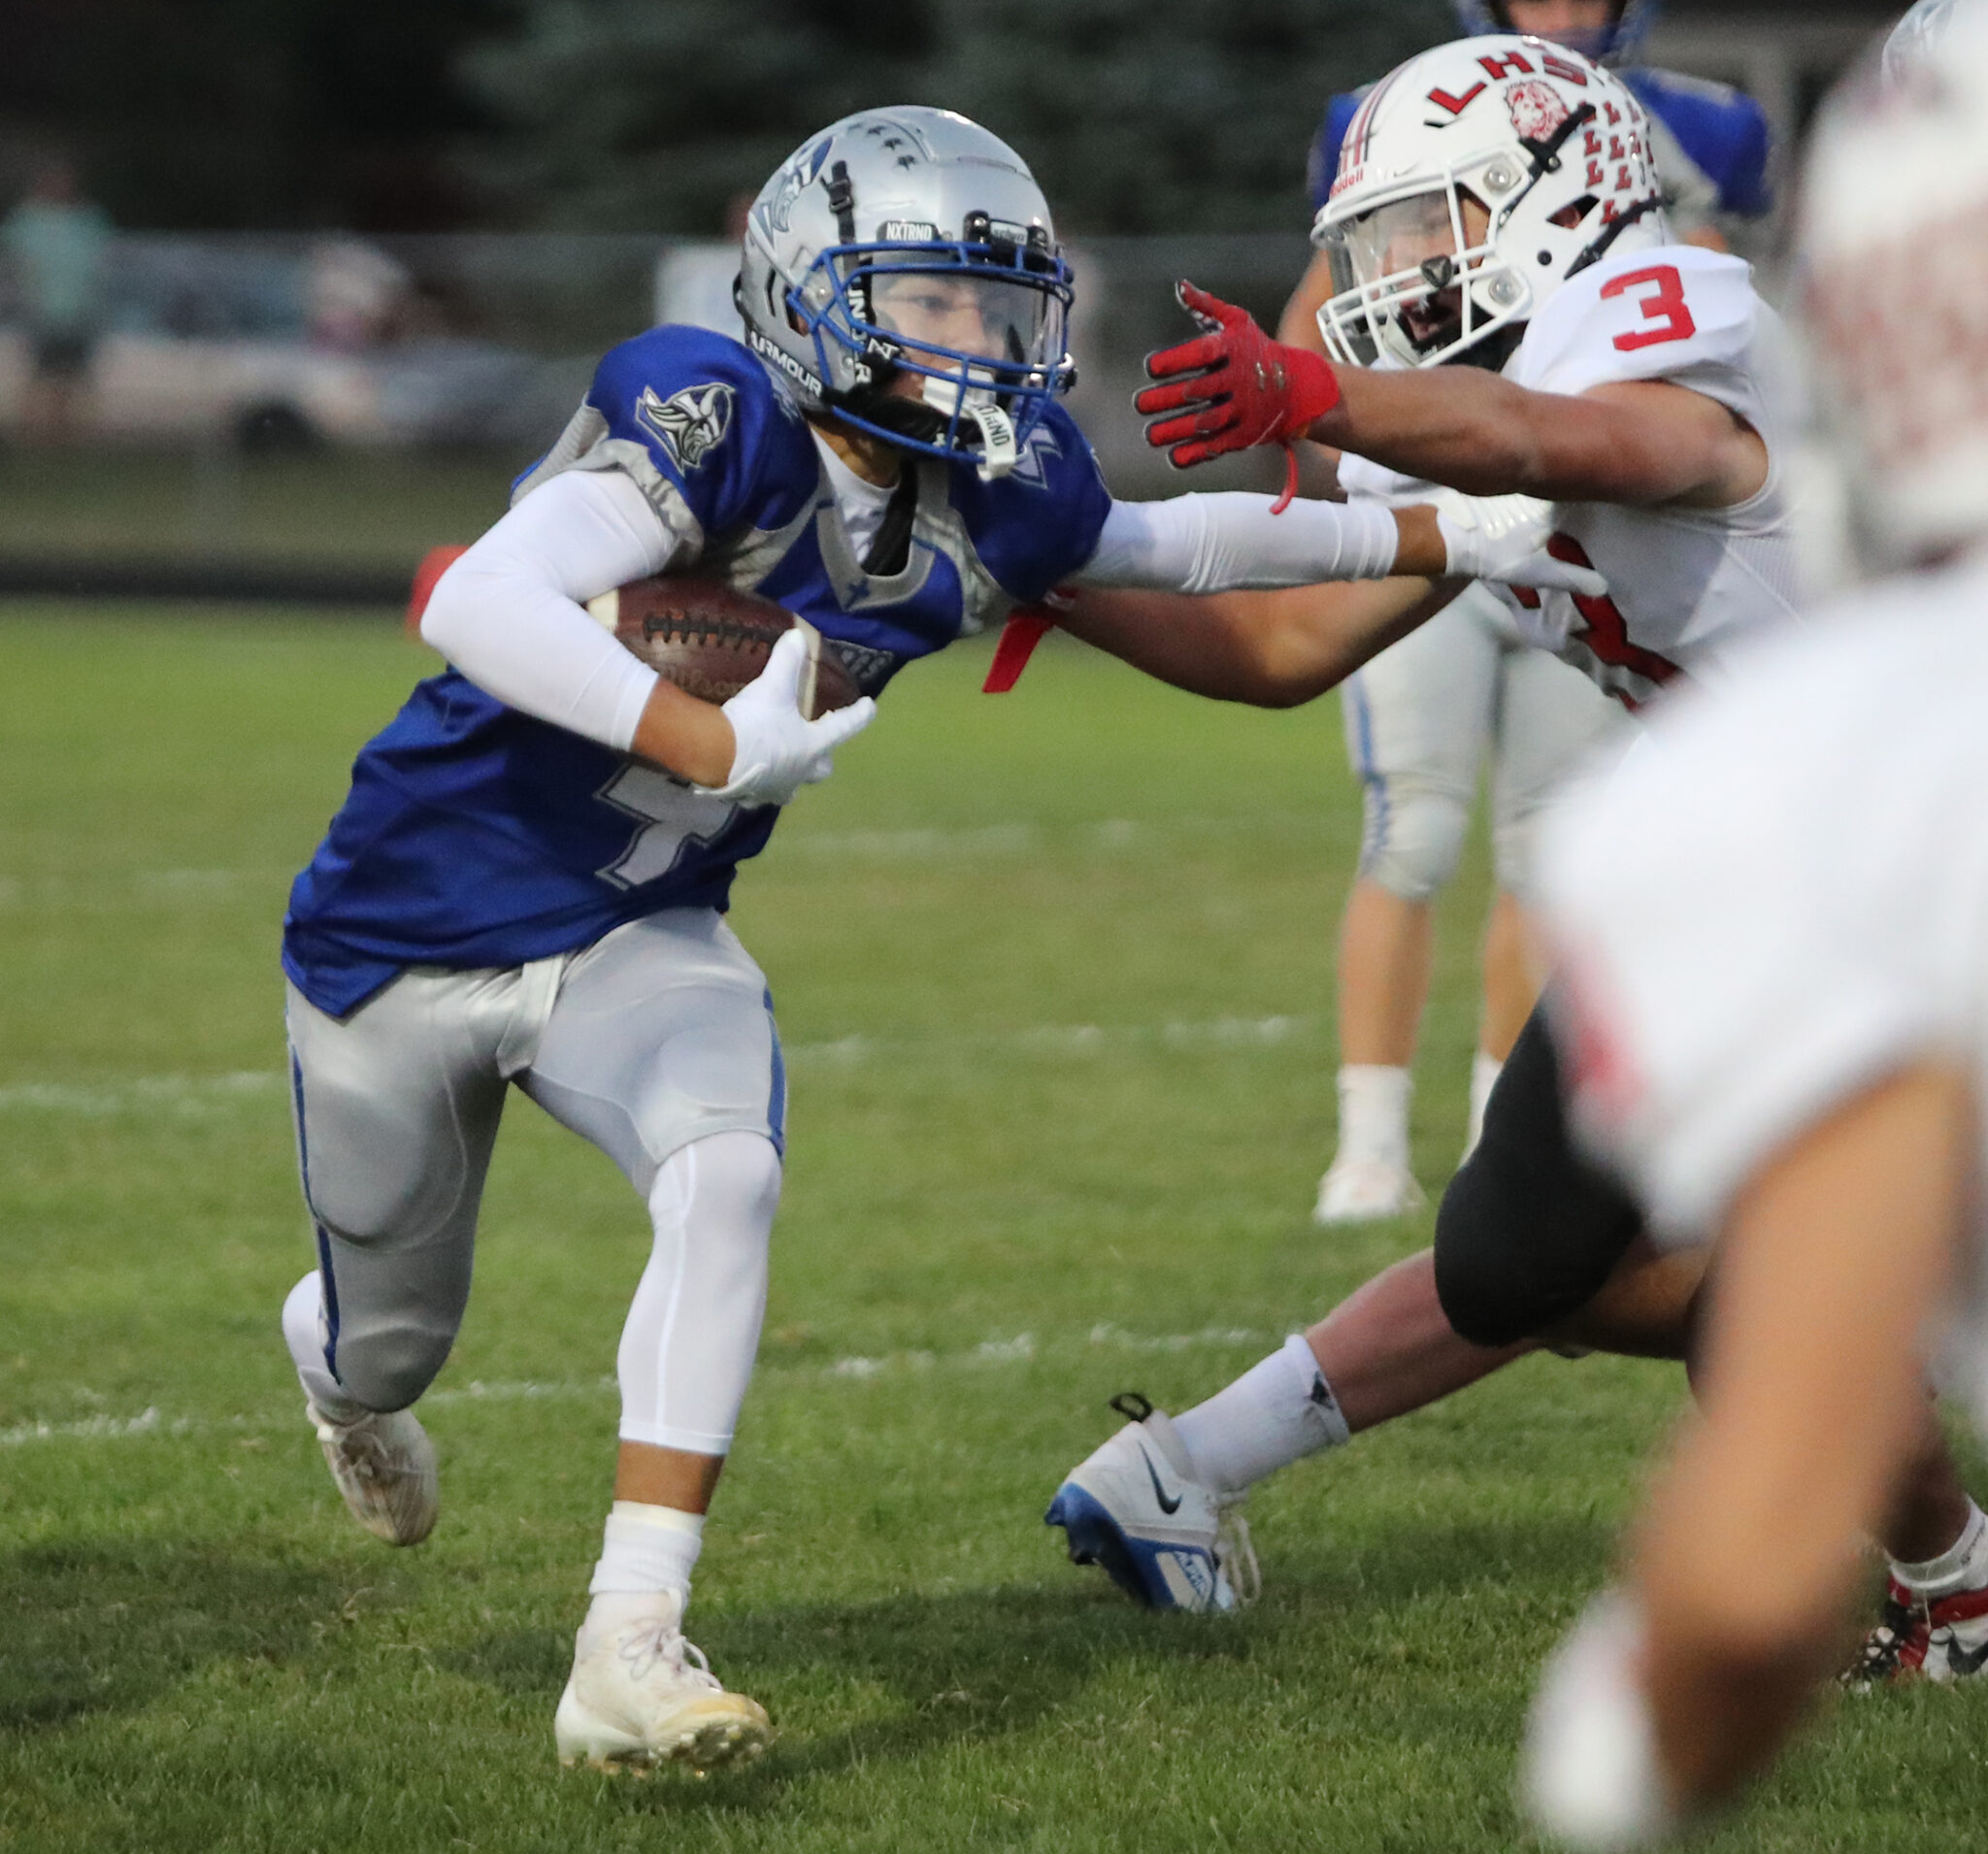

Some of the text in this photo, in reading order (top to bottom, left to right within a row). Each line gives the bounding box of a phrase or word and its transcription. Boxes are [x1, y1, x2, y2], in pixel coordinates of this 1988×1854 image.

[1426, 51, 1587, 116] LHS
[885, 221, 933, 241] NXTRND
[1600, 263, 1696, 351] 3
[750, 330, 822, 397] ARMOUR
